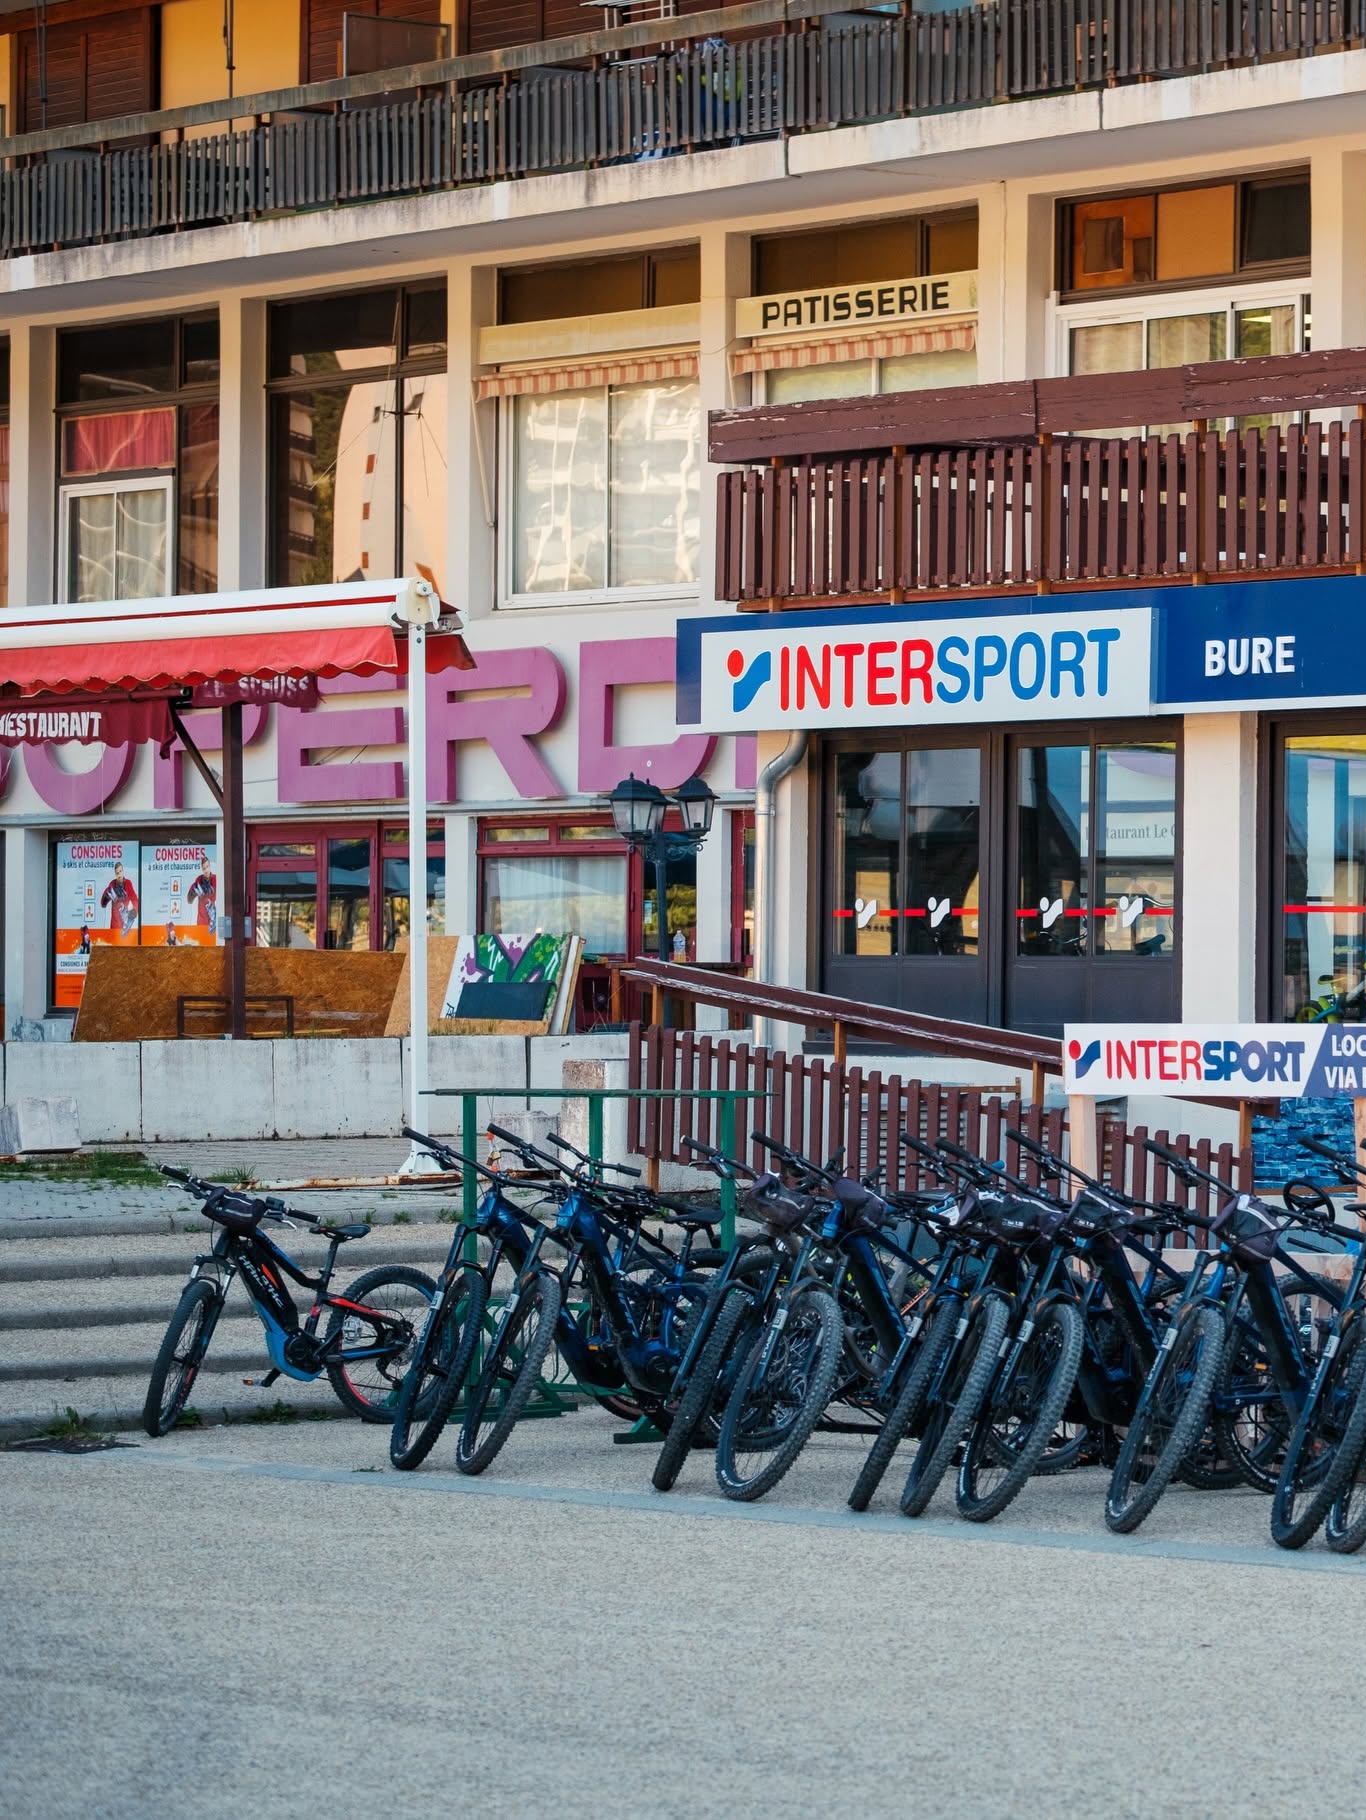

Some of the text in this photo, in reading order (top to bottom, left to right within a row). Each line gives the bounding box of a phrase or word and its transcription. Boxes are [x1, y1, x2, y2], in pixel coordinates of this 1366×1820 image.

[761, 281, 950, 329] PATISSERIE
[1204, 635, 1296, 678] BURE
[779, 628, 1121, 711] INTERSPORT
[67, 860, 77, 868] skis
[85, 860, 115, 868] chaussures
[71, 845, 123, 860] CONSIGNES
[155, 847, 206, 861] CONSIGNES
[153, 862, 163, 871] skis
[164, 862, 170, 870] et
[170, 862, 201, 870] chaussures
[1106, 1039, 1306, 1083] INTERSPORT
[1324, 1066, 1356, 1089] VIA
